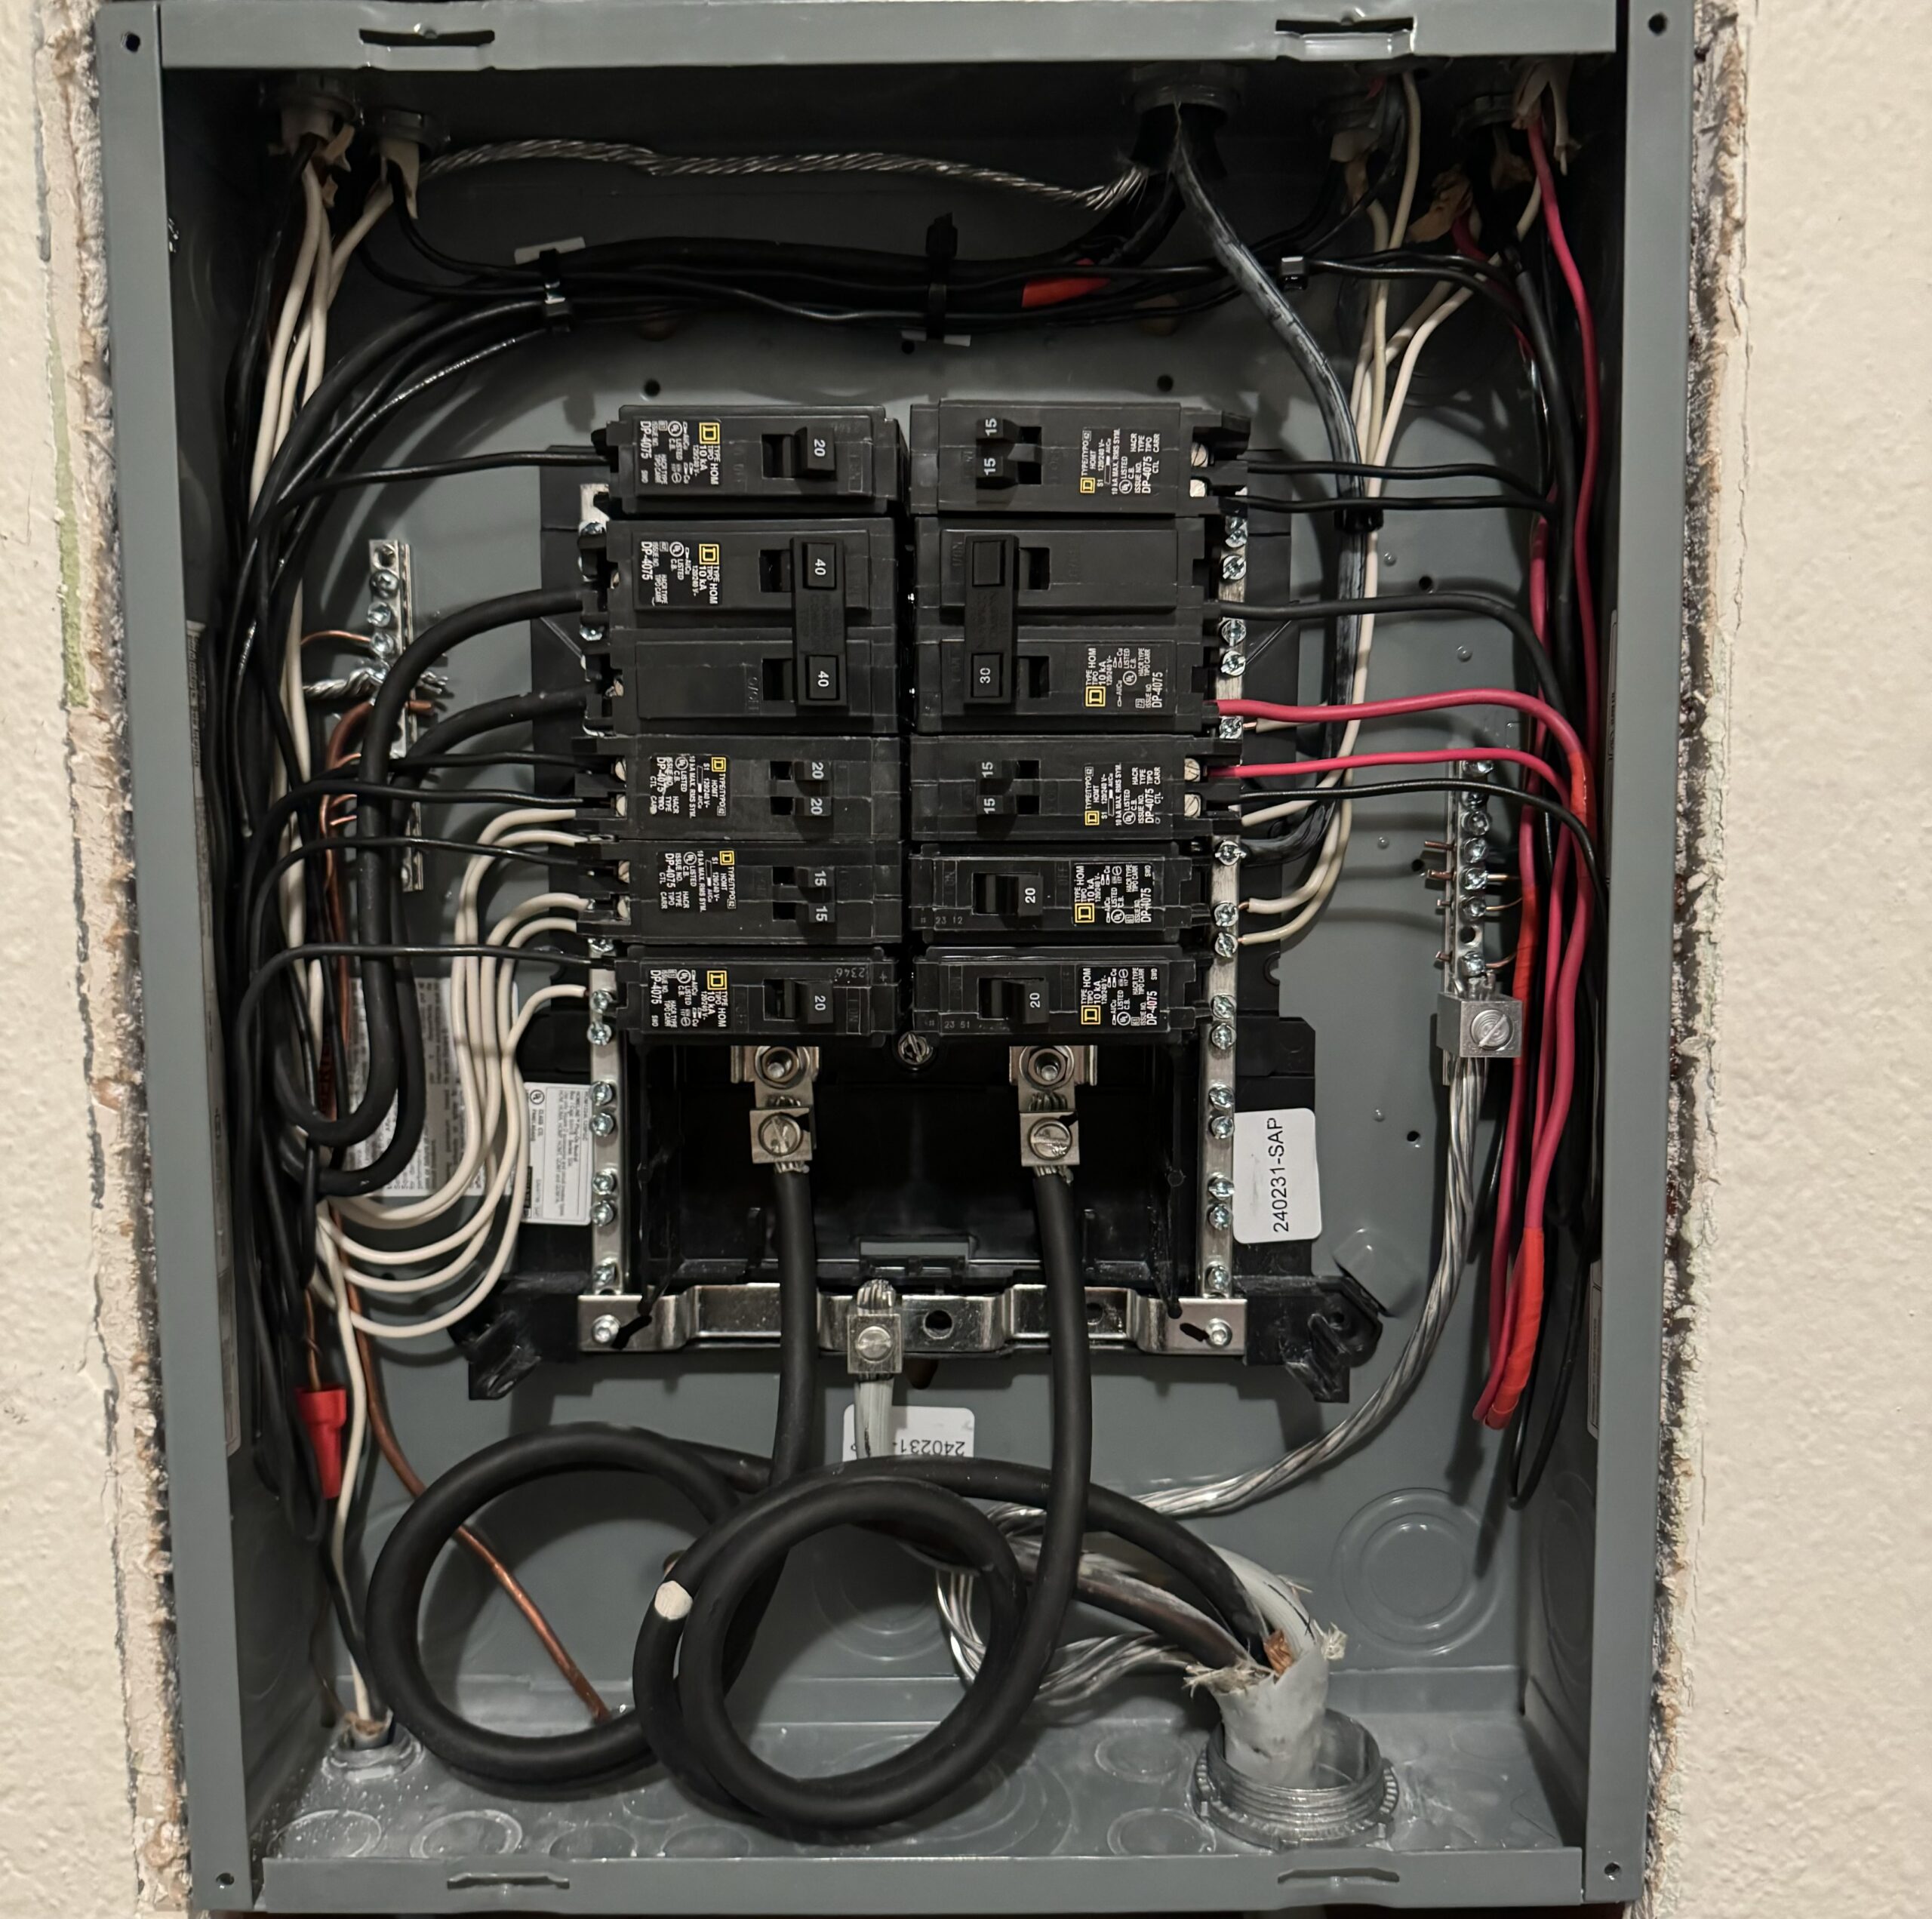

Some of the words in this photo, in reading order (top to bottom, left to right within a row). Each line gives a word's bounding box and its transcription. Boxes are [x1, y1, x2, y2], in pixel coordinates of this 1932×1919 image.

[986, 418, 996, 435] 15
[641, 421, 651, 459] DP-4075
[814, 439, 826, 457] 20
[700, 445, 707, 456] 10
[700, 459, 707, 470] kA
[984, 458, 995, 475] 15
[1143, 456, 1152, 494] DP-4075
[641, 542, 653, 580] DP-4075
[815, 559, 826, 576] 40
[700, 566, 706, 577] 10
[700, 579, 706, 590] kA
[709, 583, 718, 604] HOM
[1099, 661, 1106, 672] kA
[817, 670, 829, 687] 40
[980, 667, 990, 684] 30
[1099, 675, 1106, 685] 10
[1152, 672, 1163, 708] DP-4075
[657, 758, 666, 792] DP-4075
[812, 762, 823, 779] 20
[982, 761, 993, 777] 15
[811, 798, 822, 815] 20
[984, 798, 995, 813] 15
[1146, 789, 1154, 823] DP-4075
[665, 853, 675, 887] DP-4075
[815, 871, 826, 886] 15
[1087, 878, 1094, 889] kA
[1026, 887, 1035, 903] 20
[1088, 891, 1094, 902] 10
[817, 906, 828, 921] 15
[651, 970, 662, 1004] DP-4075
[1094, 981, 1100, 992] kA
[708, 992, 714, 1001] 10
[814, 995, 826, 1011] 20
[1030, 992, 1040, 1008] 20
[1094, 994, 1100, 1004] 10
[708, 1004, 715, 1014] kA
[1147, 991, 1157, 1026] DP-4075
[718, 1008, 726, 1027] HOM
[1267, 1118, 1288, 1232] 240231-SAP
